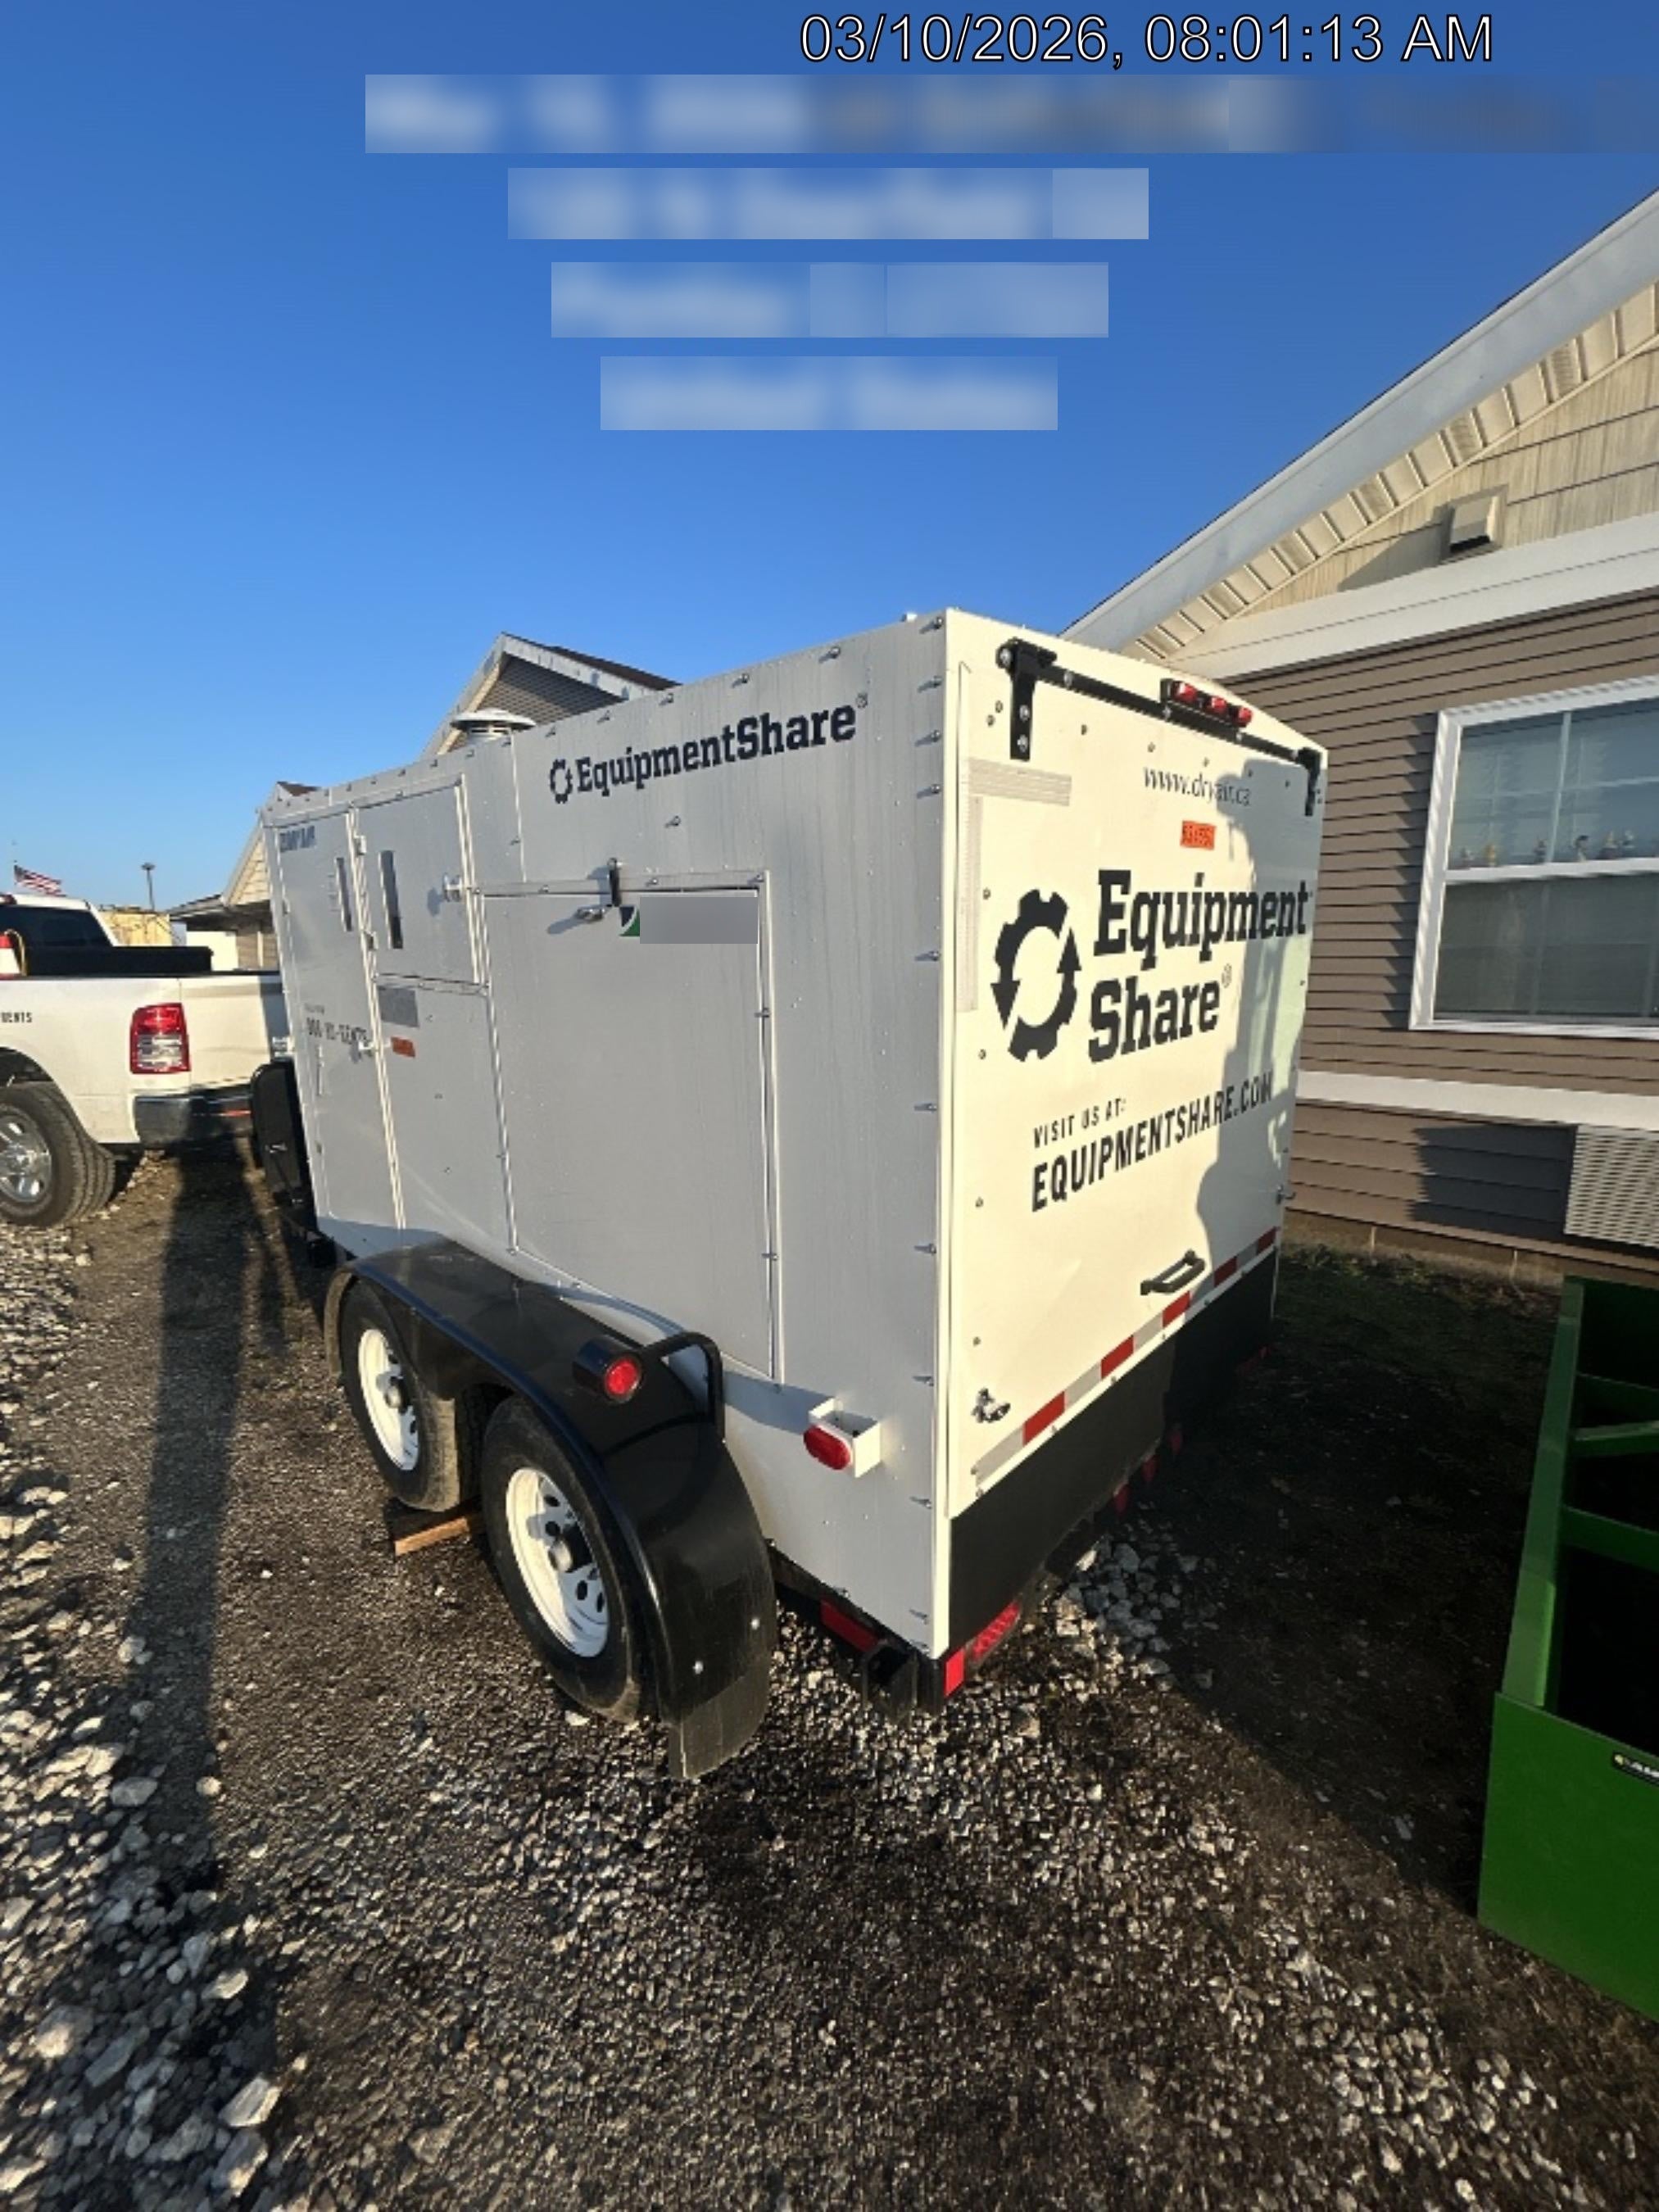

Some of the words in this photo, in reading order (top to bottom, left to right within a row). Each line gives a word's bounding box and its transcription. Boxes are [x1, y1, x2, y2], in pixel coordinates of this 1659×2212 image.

[576, 705, 856, 796] EquipmentShare
[1094, 870, 1310, 970] Equipment
[1088, 975, 1221, 1063] Share
[1032, 1071, 1271, 1213] EQUIPMENTSHARE.COM
[1034, 1115, 1075, 1149] VISIT
[1081, 1106, 1099, 1129] US
